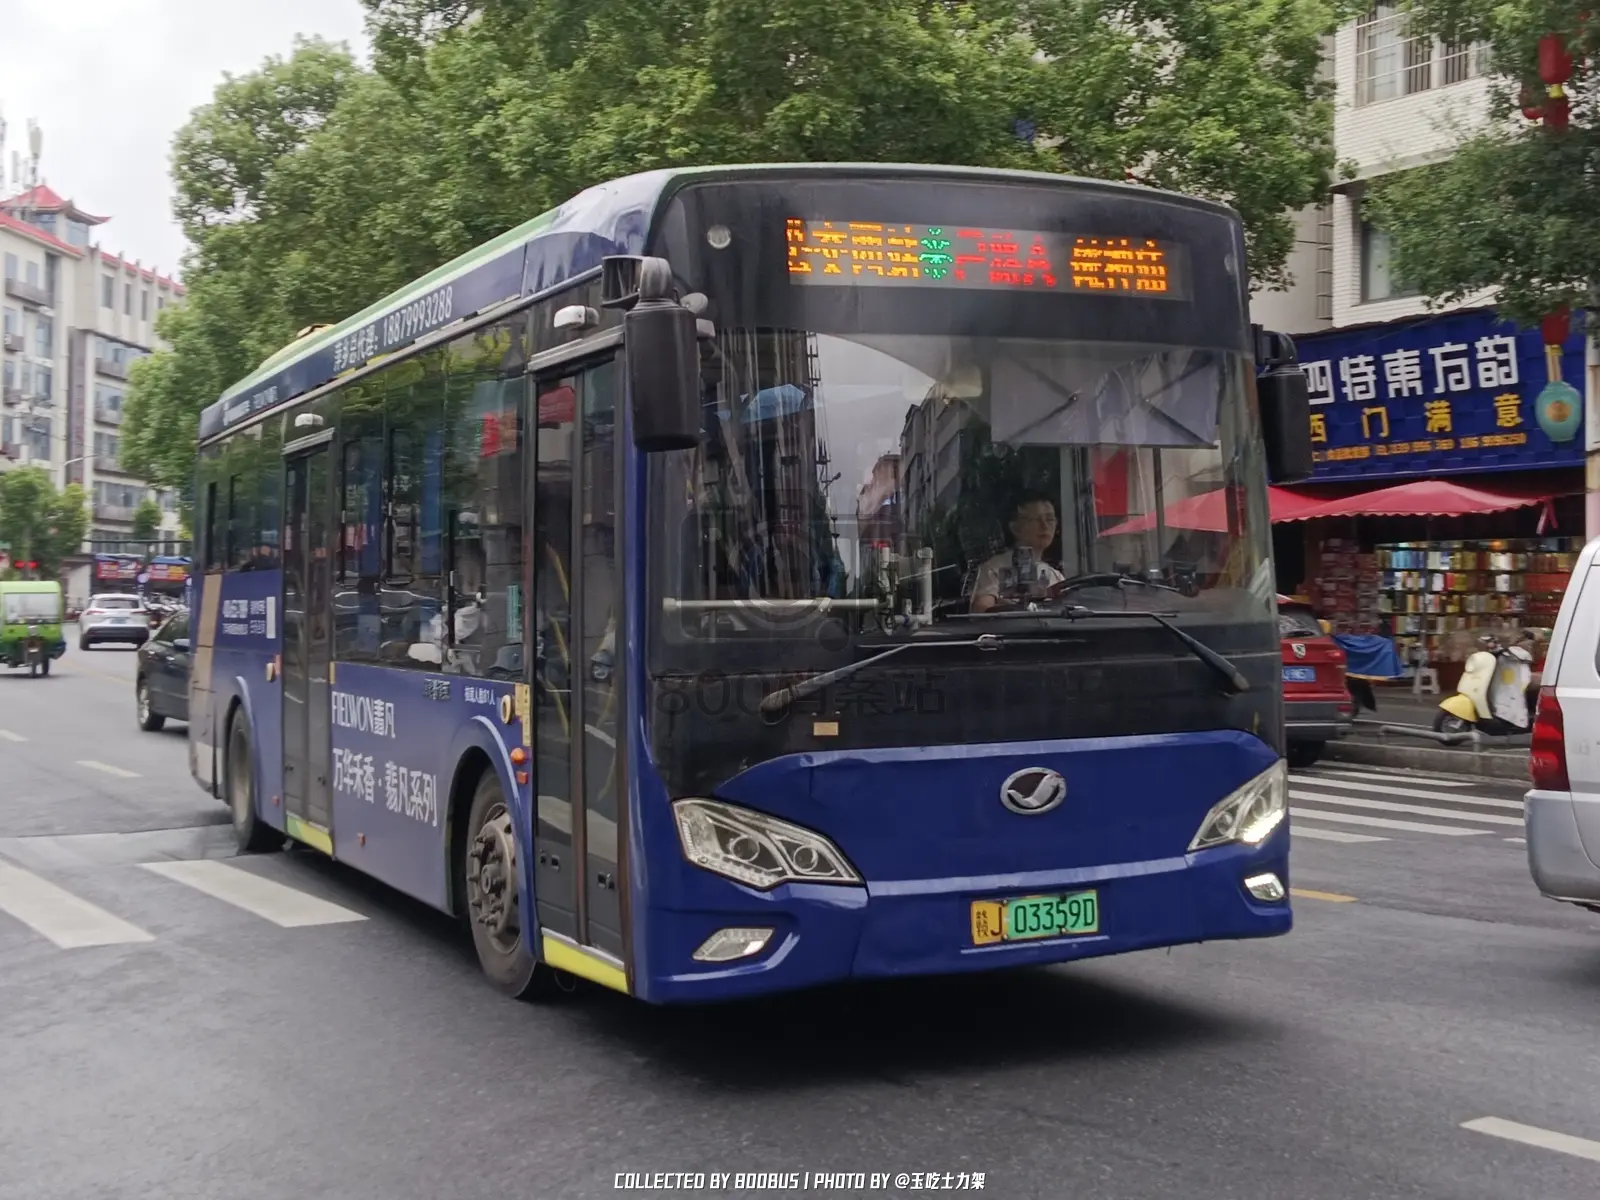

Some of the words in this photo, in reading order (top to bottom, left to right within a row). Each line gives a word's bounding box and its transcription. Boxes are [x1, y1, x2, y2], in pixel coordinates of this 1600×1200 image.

[383, 286, 453, 346] 18879993288
[1298, 334, 1520, 406] 四特東方韵
